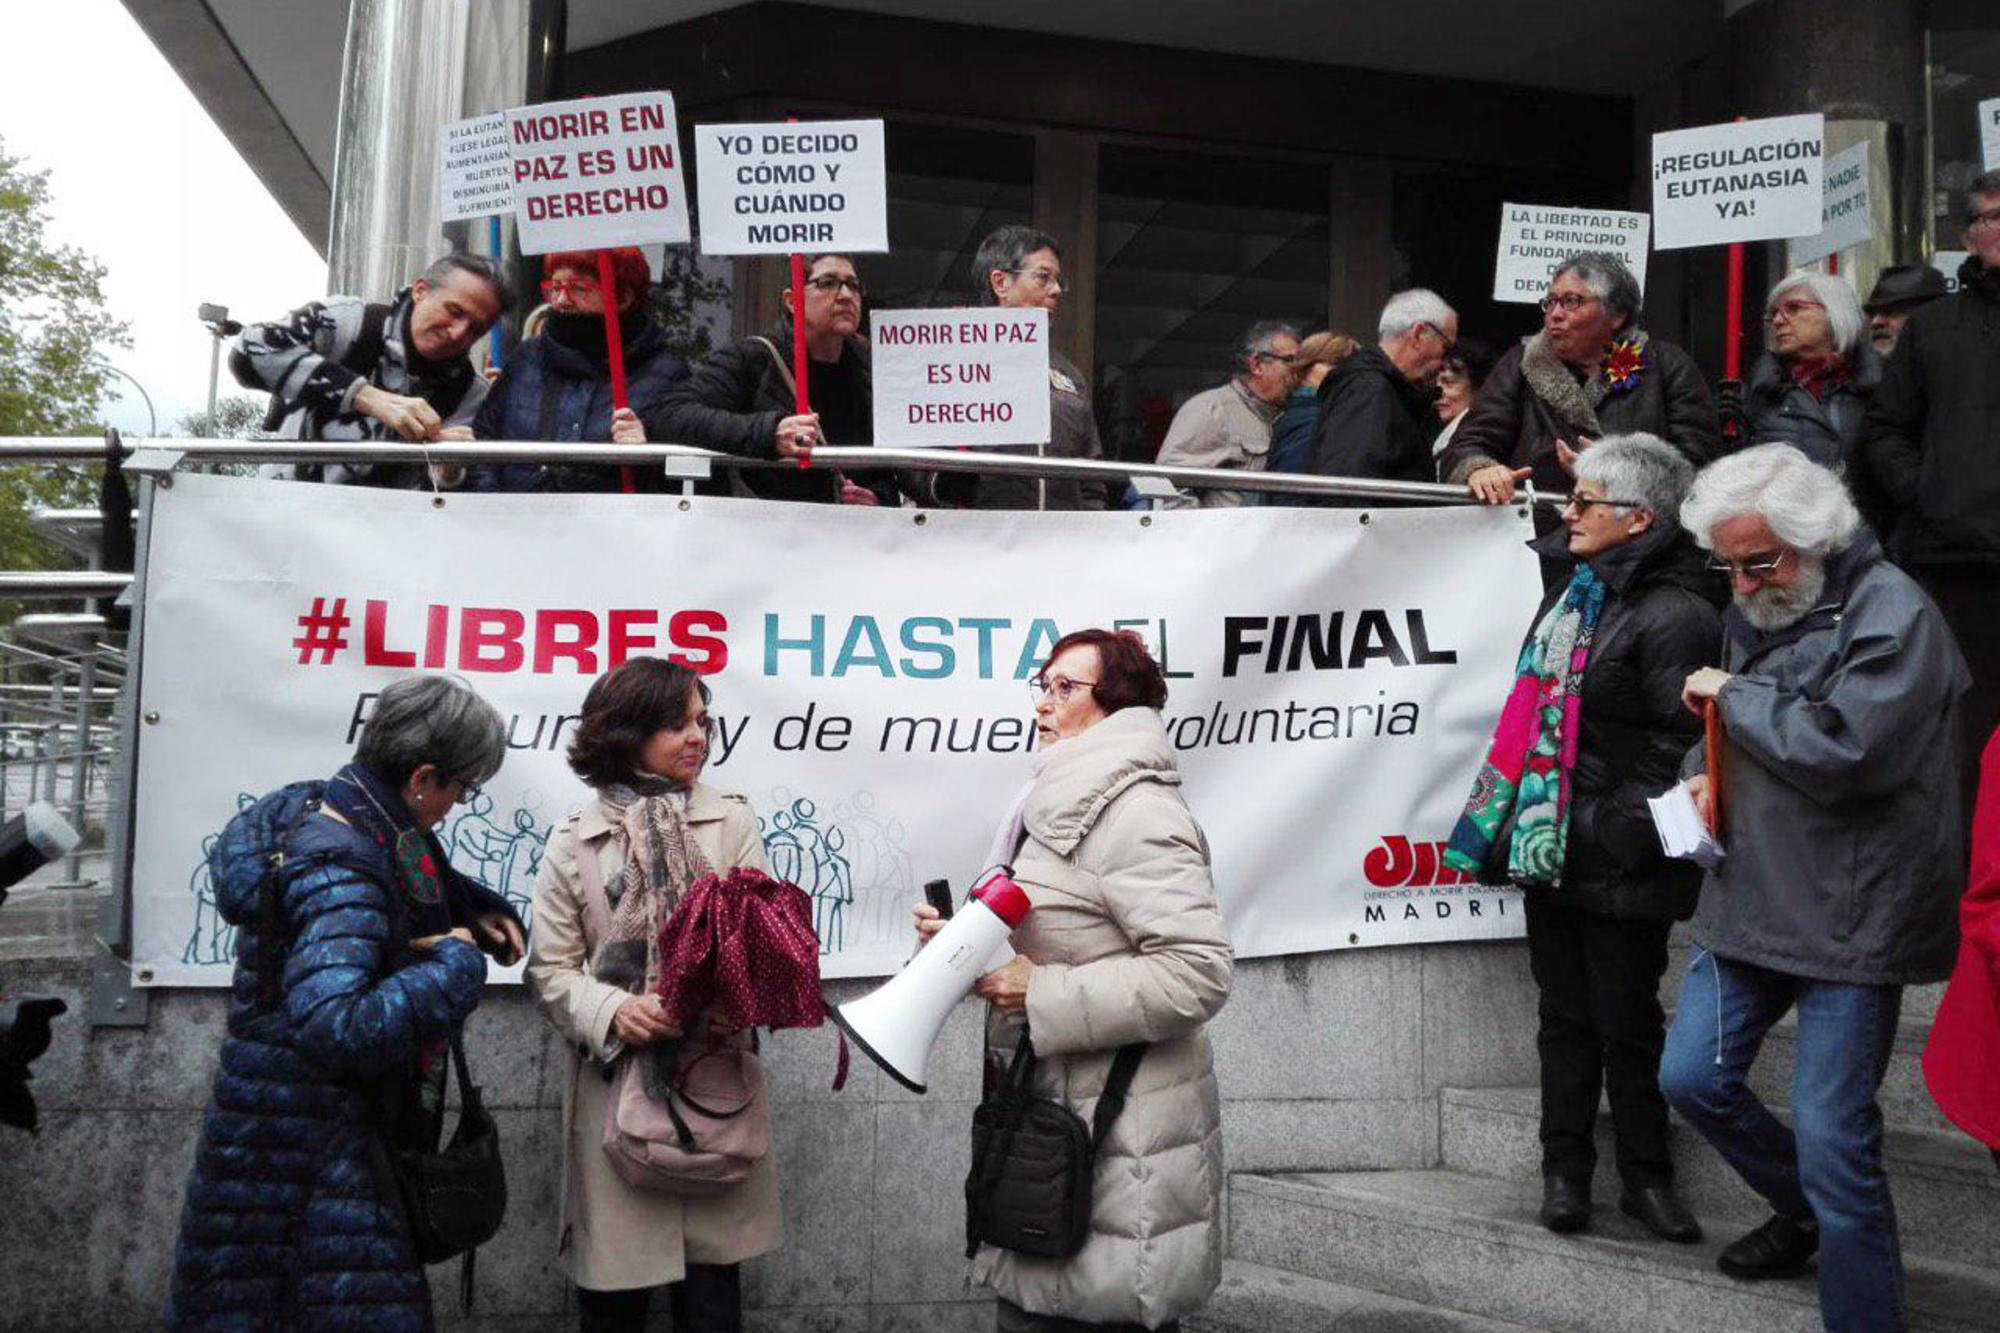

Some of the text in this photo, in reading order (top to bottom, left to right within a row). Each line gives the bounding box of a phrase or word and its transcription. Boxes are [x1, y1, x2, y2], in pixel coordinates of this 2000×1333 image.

[474, 121, 504, 135] EUTAN
[513, 104, 665, 144] MORIR EN
[717, 134, 858, 155] YO DECIDO
[514, 143, 674, 183] PAZ ES UN
[1655, 138, 1821, 180] ¡REGULACIÓN
[736, 160, 840, 184] CÓMO Y
[1667, 168, 1808, 199] EUTANASIA
[1829, 164, 1860, 191] NADIE
[527, 185, 668, 221] DERECHO
[734, 189, 845, 214] CUÁNDO
[1715, 199, 1755, 219] YA!
[1831, 198, 1852, 220] POR
[1511, 210, 1638, 229] LA LIBERTAD ES
[748, 223, 834, 243] MORIR
[1521, 228, 1626, 246] EL PRINCIPIO
[879, 323, 1037, 344] MORIR EN PAZ
[927, 364, 990, 384] ES UN
[908, 402, 1013, 424] DERECHO
[293, 597, 728, 675] #LIBRES
[763, 613, 1060, 680] HASTA
[1222, 609, 1457, 677] FINAL
[773, 702, 852, 751] de
[1365, 898, 1505, 923] MADRI
